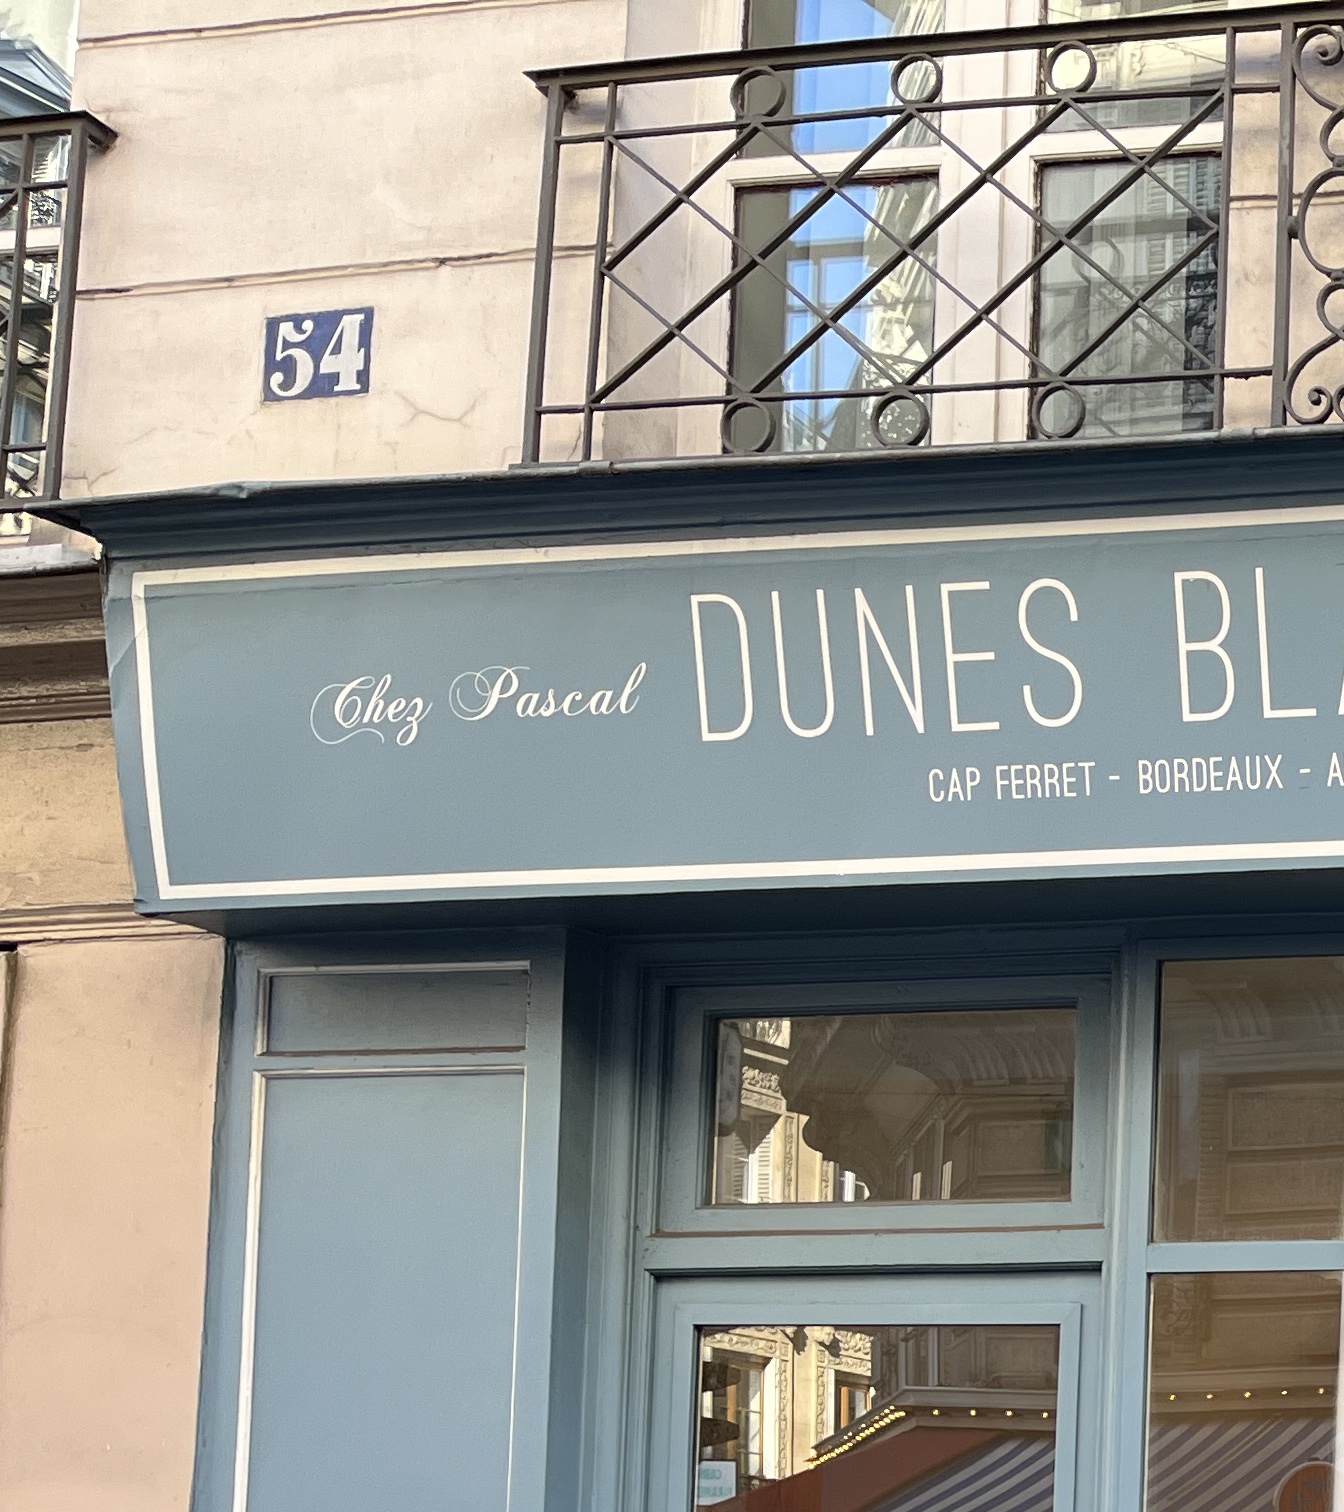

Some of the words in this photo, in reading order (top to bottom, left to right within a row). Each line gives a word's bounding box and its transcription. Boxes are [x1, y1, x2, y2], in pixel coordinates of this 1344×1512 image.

[270, 313, 365, 397] 54
[690, 577, 1083, 743] DUNES
[310, 674, 433, 747] Chez
[449, 661, 647, 722] Pascal
[928, 767, 981, 803] CAP
[995, 761, 1096, 800] FERRET
[1138, 754, 1284, 795] BORDEAUX
